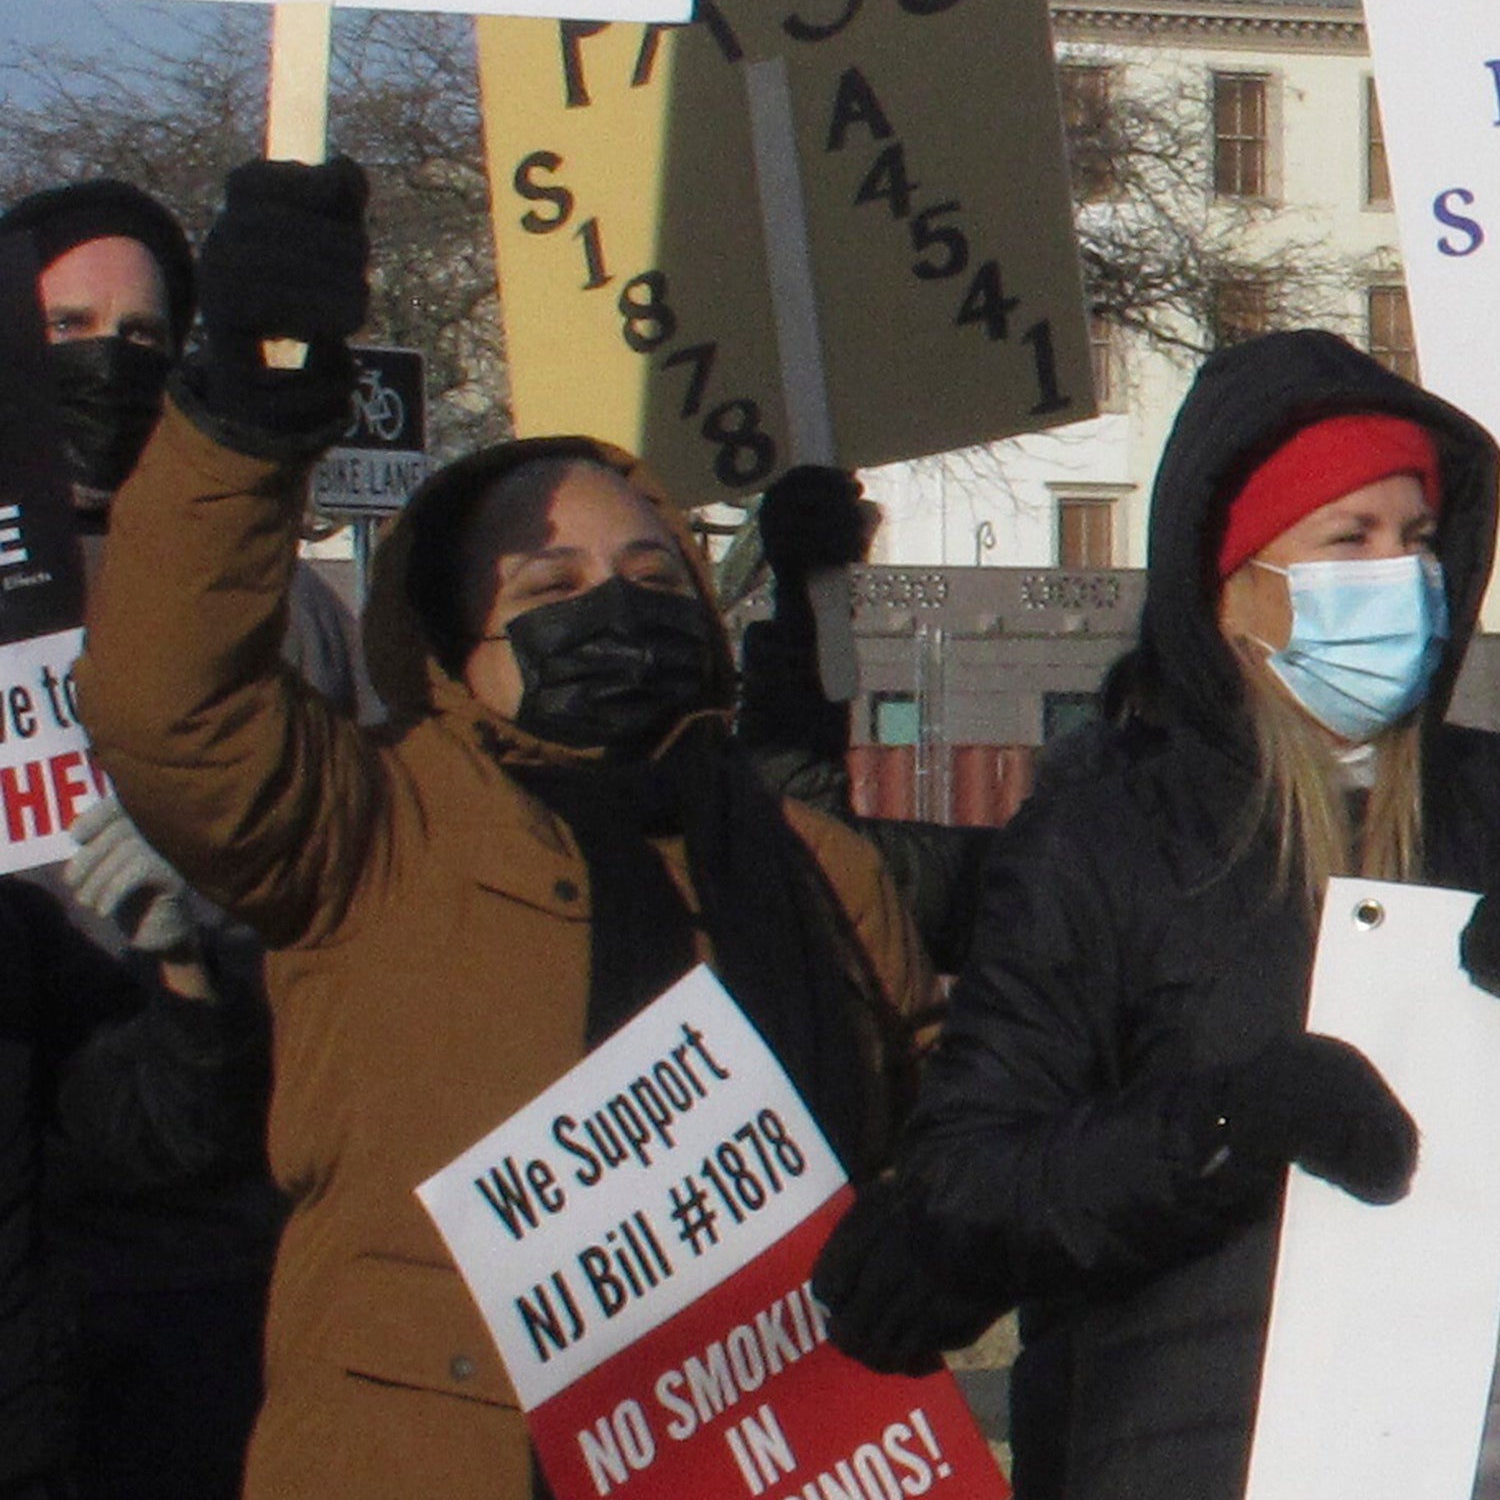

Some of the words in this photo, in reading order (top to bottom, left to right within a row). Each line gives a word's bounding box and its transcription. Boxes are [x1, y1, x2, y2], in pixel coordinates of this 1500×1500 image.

[512, 150, 776, 488] S1878
[826, 67, 1072, 417] A4541
[474, 1154, 566, 1242] We
[551, 1020, 730, 1188] Support
[513, 1272, 585, 1364] NJ
[579, 1208, 674, 1319] Bill
[669, 1106, 806, 1257] #1878
[577, 1399, 656, 1497] NO
[655, 1279, 830, 1441] SMOKI
[725, 1404, 797, 1496] IN
